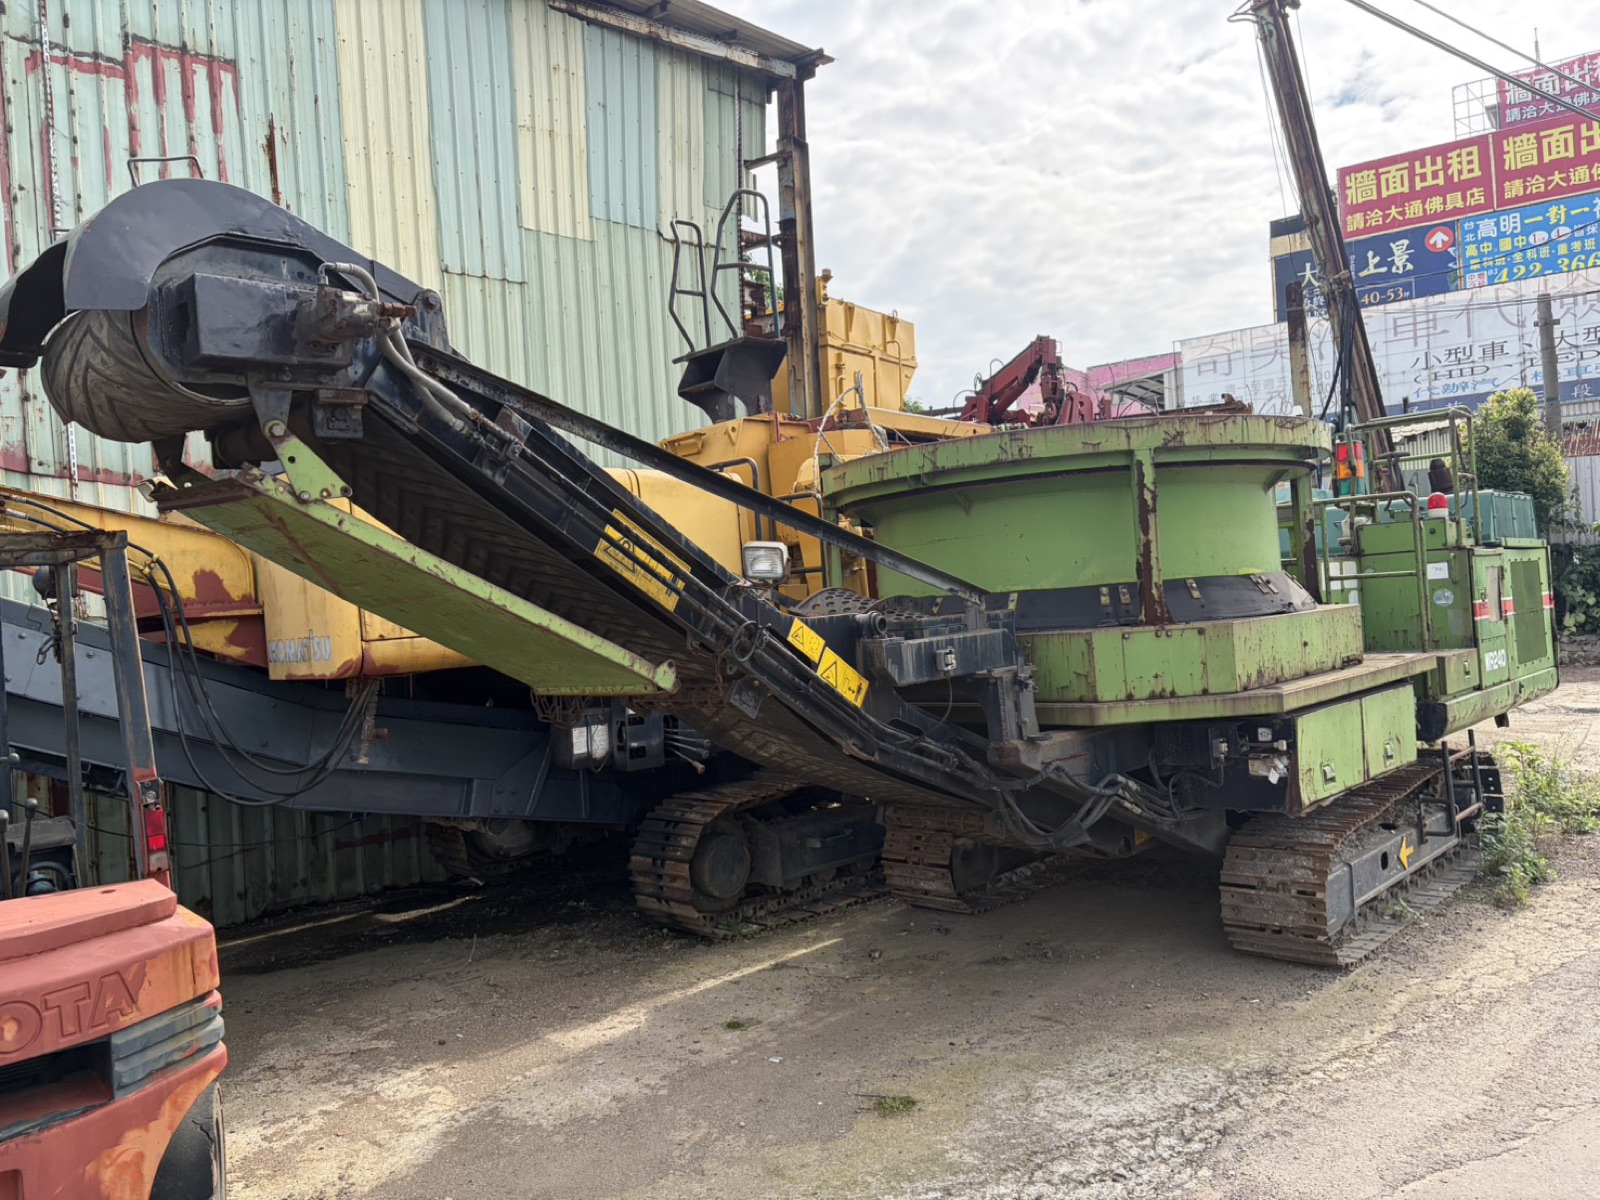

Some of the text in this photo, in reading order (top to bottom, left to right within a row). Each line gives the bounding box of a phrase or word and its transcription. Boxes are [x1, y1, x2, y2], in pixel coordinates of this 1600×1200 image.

[1505, 56, 1600, 105] 牆面出
[1345, 146, 1482, 206] 牆面出租
[1346, 187, 1486, 232] 請洽大通佛具店
[1358, 239, 1415, 277] 上景
[0, 970, 138, 1055] OTA
